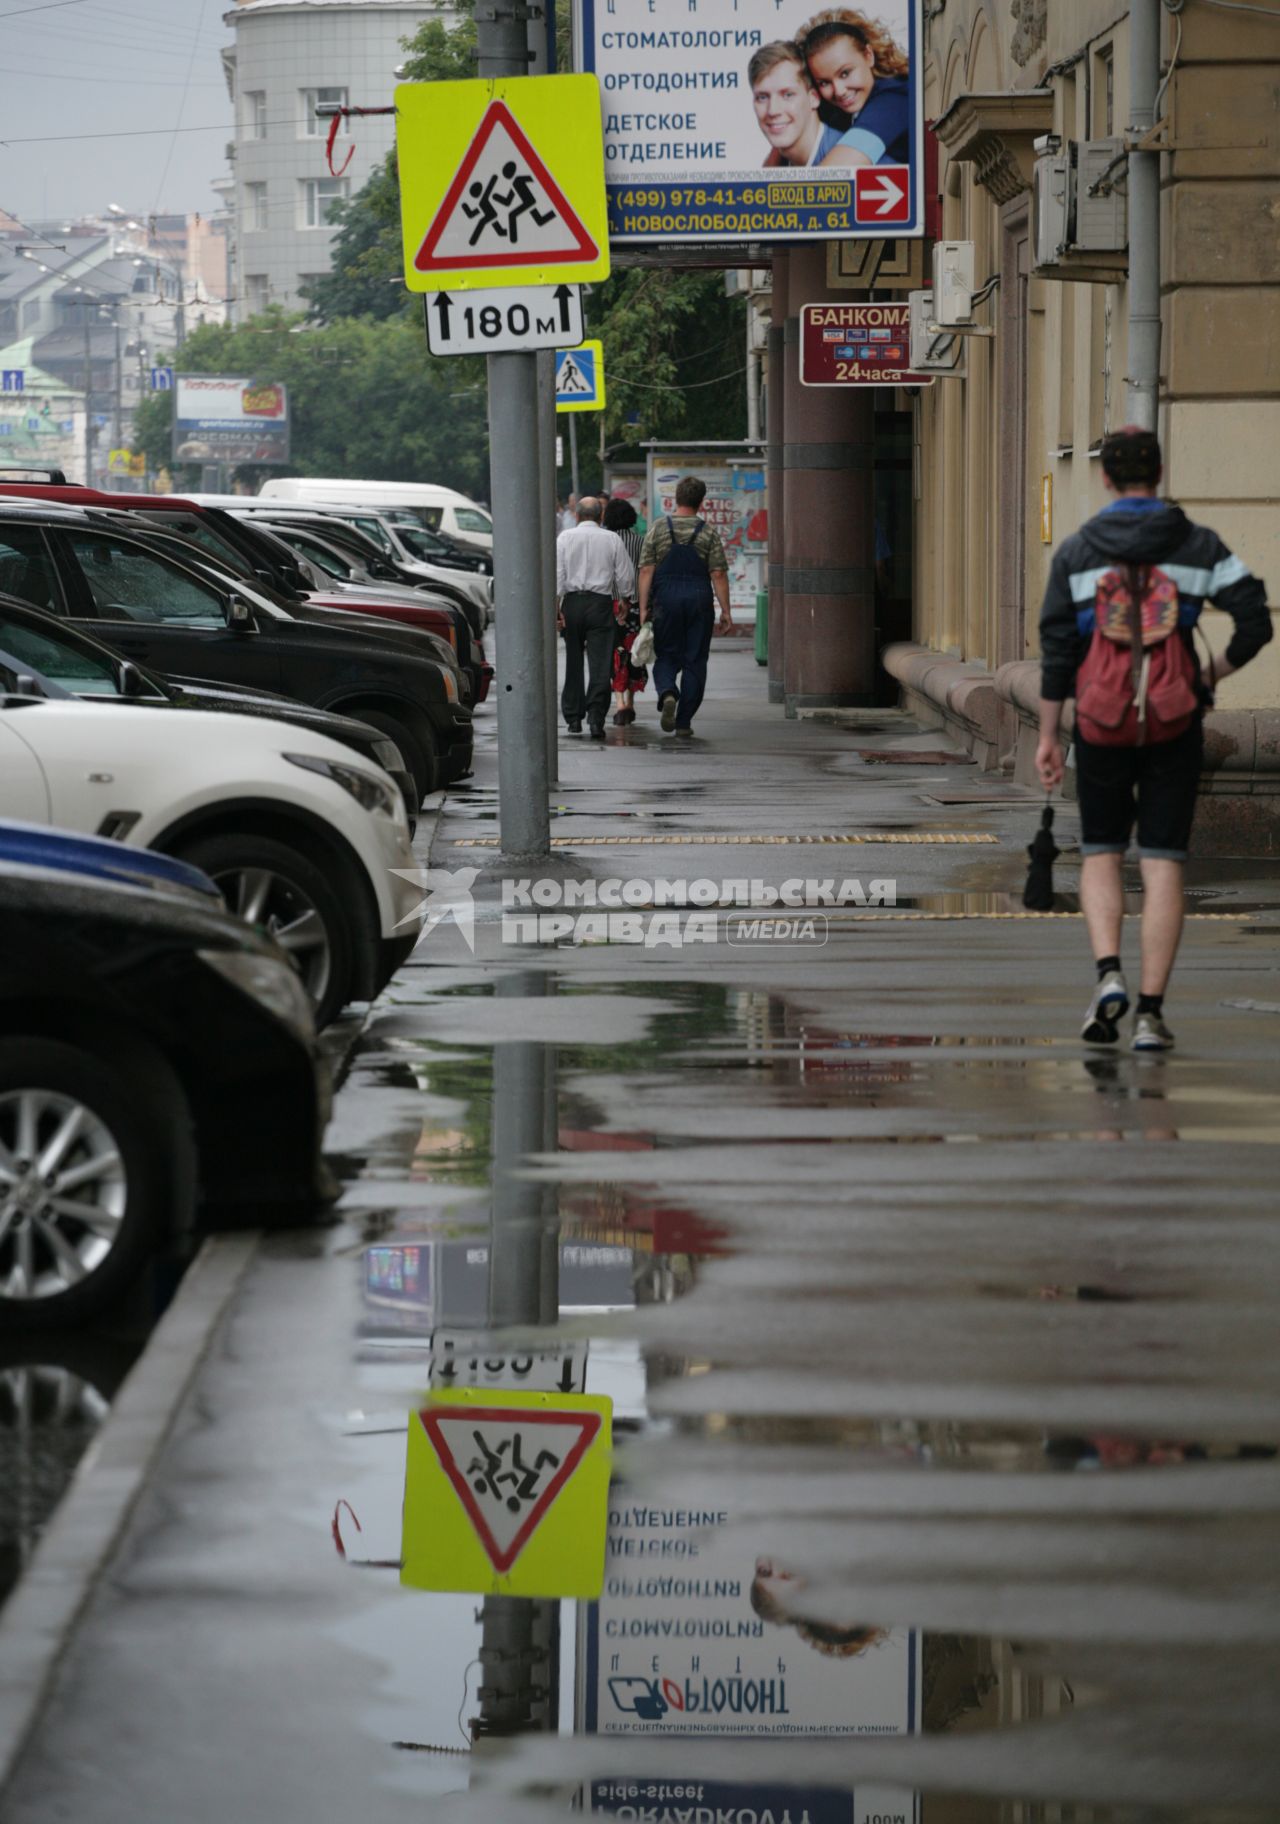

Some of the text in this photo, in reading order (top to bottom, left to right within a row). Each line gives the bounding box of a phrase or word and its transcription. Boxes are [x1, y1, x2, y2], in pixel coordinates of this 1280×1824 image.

[602, 30, 761, 49] СТОМАТОЛОГИЯ
[604, 72, 738, 93] ОРТОДОНТИЯ
[605, 113, 696, 134] ДЕТСКОЕ
[605, 142, 726, 162] ОТДЕЛЕНИЕ
[616, 188, 766, 210] (499) 978-41-66
[772, 186, 847, 205] ВХОД В АРКУ
[624, 213, 803, 232] НОВОСЛОБОДСКАЯ,
[808, 216, 822, 230] д.
[826, 212, 850, 229] 61
[464, 303, 530, 339] 180
[810, 308, 911, 326] БАНКОМА
[703, 499, 733, 510] CTIC
[697, 512, 740, 523] NKEYS
